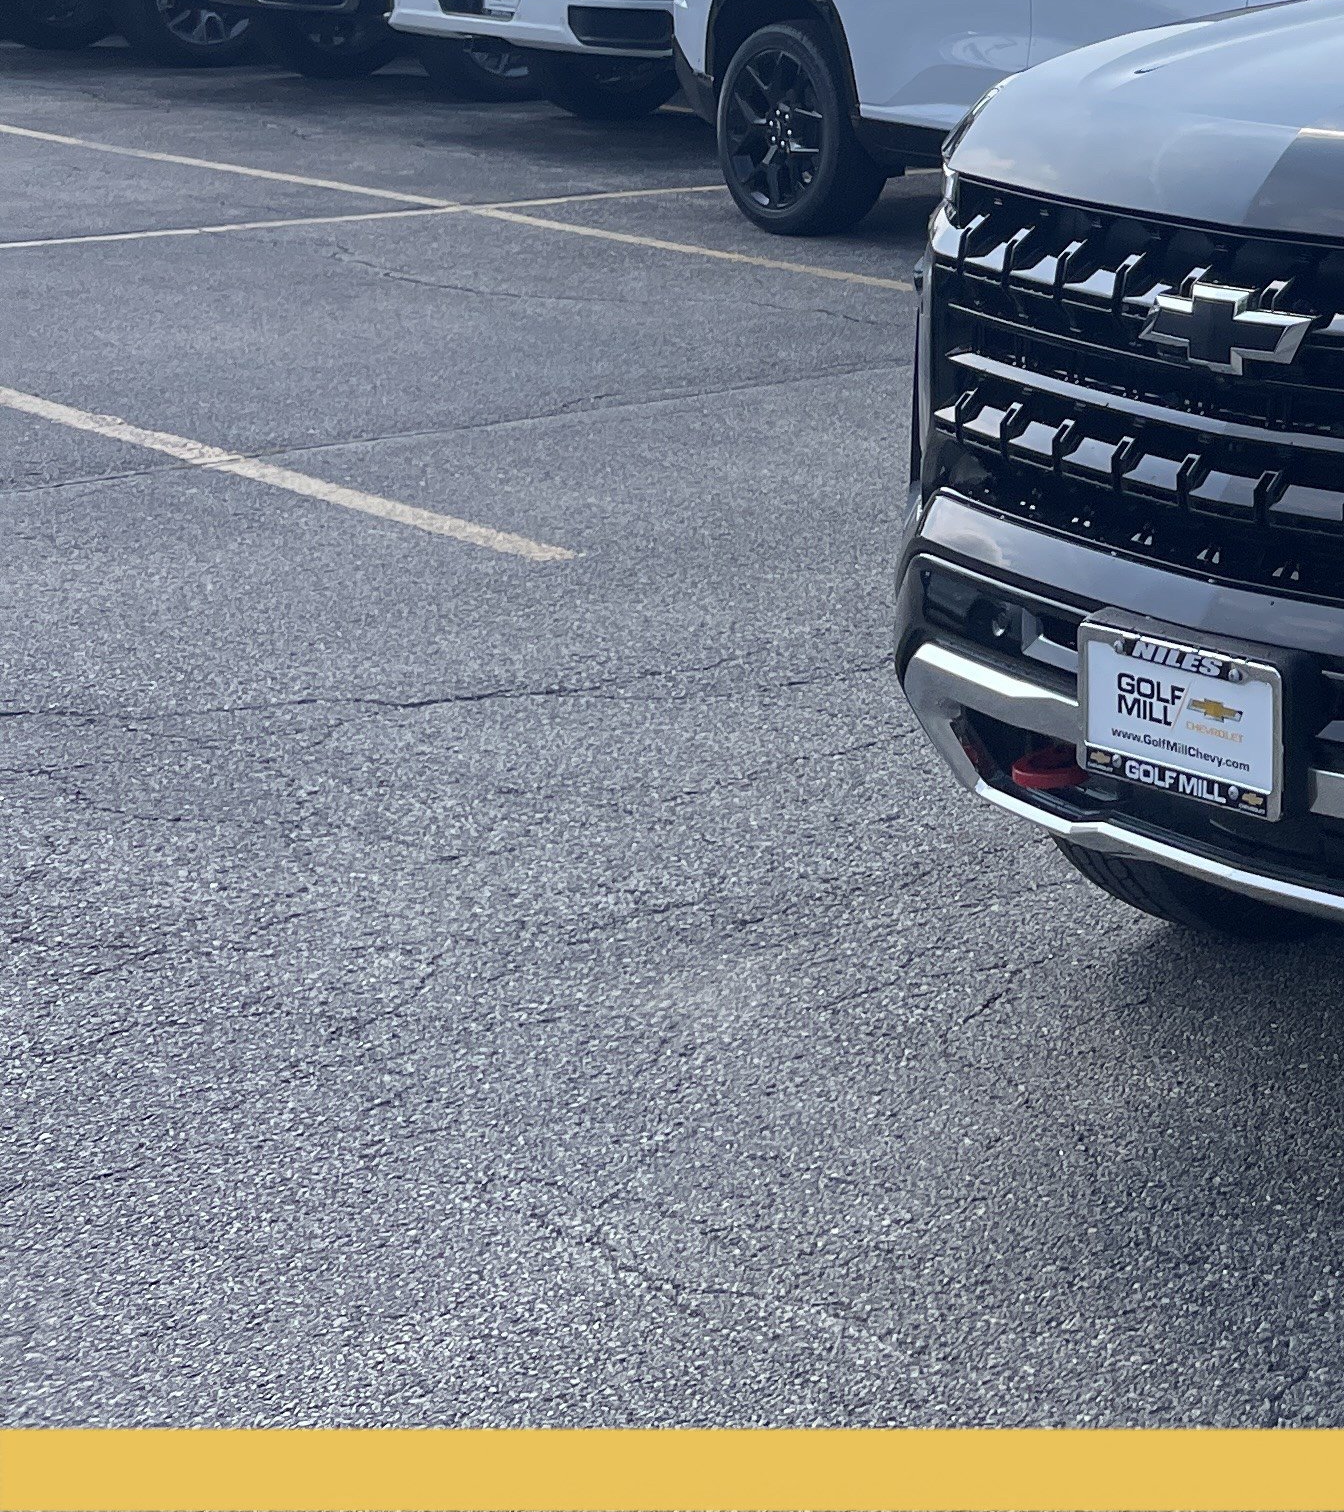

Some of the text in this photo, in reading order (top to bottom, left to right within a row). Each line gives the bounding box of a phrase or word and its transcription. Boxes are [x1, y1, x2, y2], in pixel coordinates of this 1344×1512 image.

[1132, 641, 1222, 677] NILES
[1117, 672, 1186, 706] GOLF
[1117, 693, 1173, 727] MILL
[1111, 727, 1250, 772] www.GolfMillChevy.com
[1124, 760, 1227, 804] GOLF MILL
